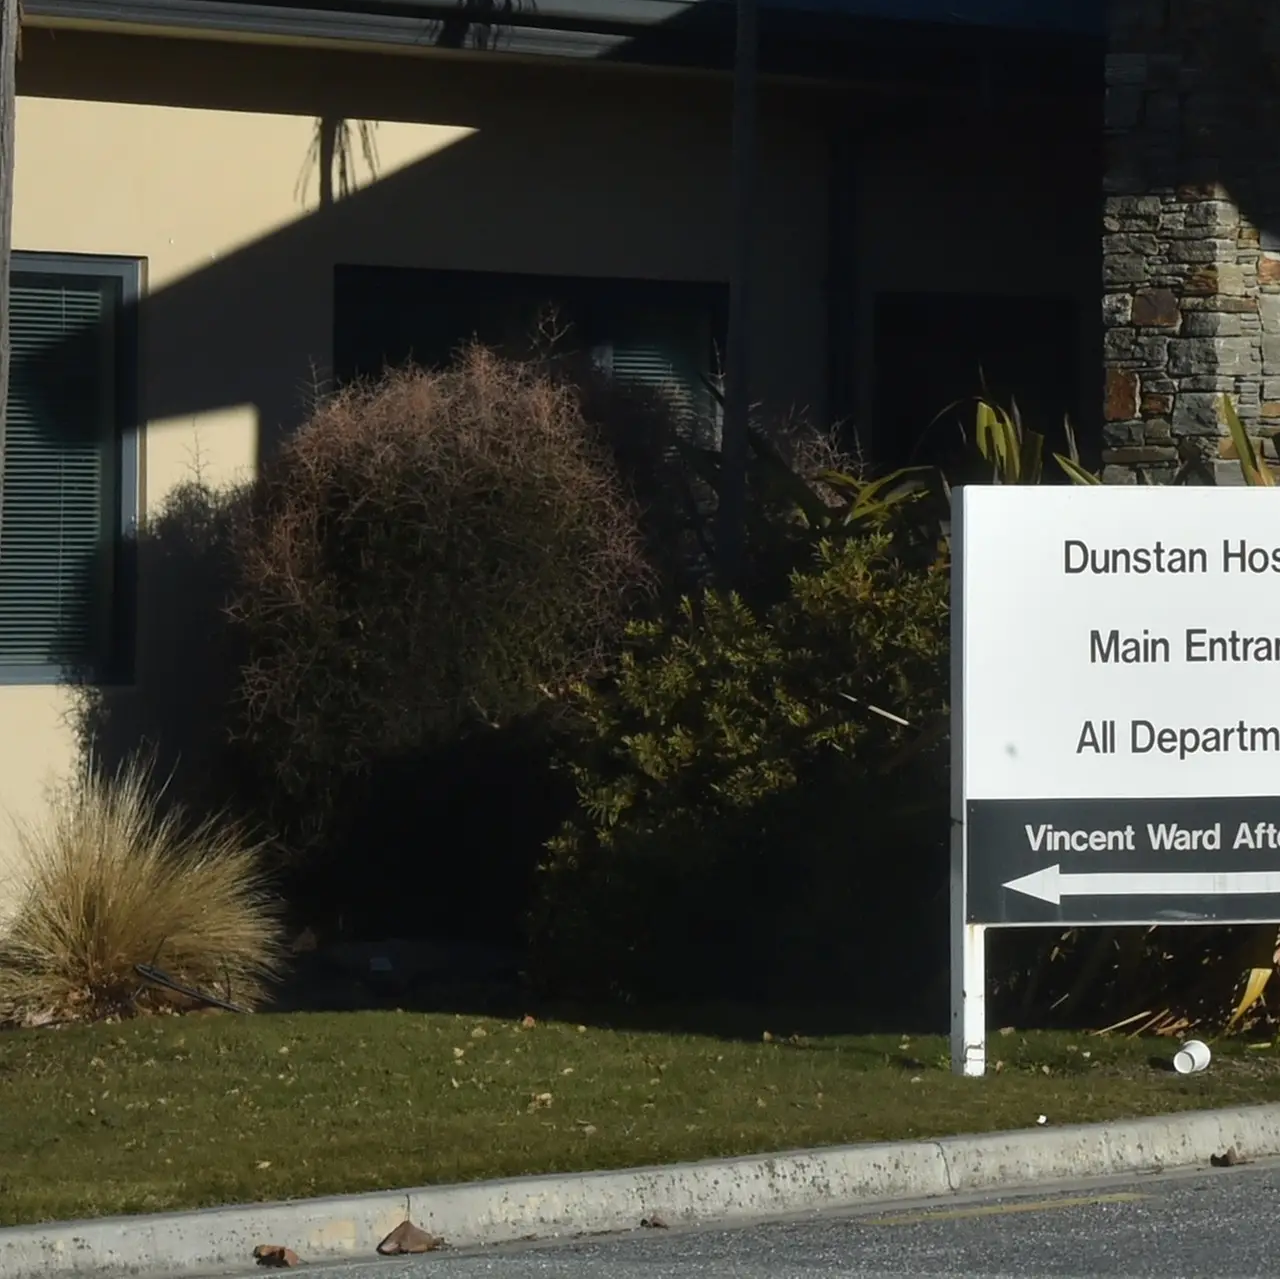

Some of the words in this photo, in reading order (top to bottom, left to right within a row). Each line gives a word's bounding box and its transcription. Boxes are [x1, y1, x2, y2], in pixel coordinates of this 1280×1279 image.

[1064, 539, 1207, 575] Dunstan
[1090, 629, 1170, 664] Main
[1076, 720, 1116, 754] All
[1025, 823, 1136, 852] Vincent
[1147, 822, 1221, 851] Ward
